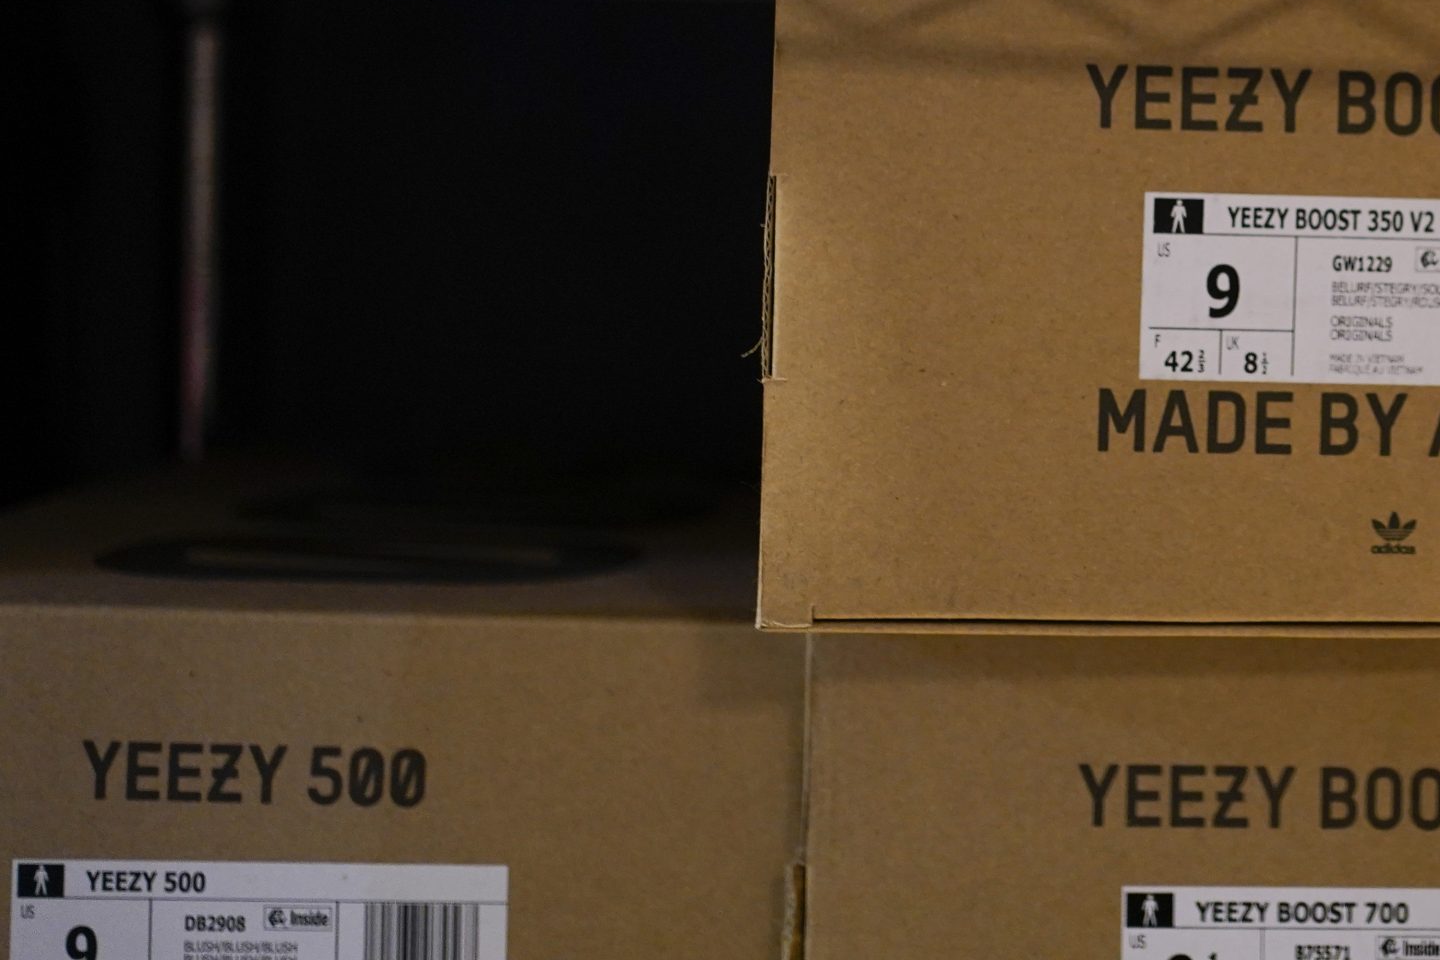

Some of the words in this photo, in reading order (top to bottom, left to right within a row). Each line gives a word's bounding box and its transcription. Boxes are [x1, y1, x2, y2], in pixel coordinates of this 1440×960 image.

[1085, 64, 1312, 133] YEEZY
[1228, 206, 1289, 229] YEEZY
[1295, 209, 1362, 231] BOOST
[1368, 210, 1403, 232] 350
[1410, 212, 1435, 233] V2
[1333, 255, 1392, 272] GW1229
[1206, 264, 1240, 318] 9
[1165, 351, 1193, 372] 42
[1244, 352, 1257, 375] 8
[1097, 388, 1293, 455] MADE
[1319, 392, 1408, 456] BY
[82, 741, 287, 805] YEEZY
[307, 746, 426, 808] 500
[1078, 763, 1296, 828] YEEZY
[86, 870, 156, 892] YEEZY
[164, 872, 206, 893] 500
[1196, 901, 1269, 923] YEEZY
[1277, 902, 1357, 924] BOOST
[1365, 903, 1409, 924] 700
